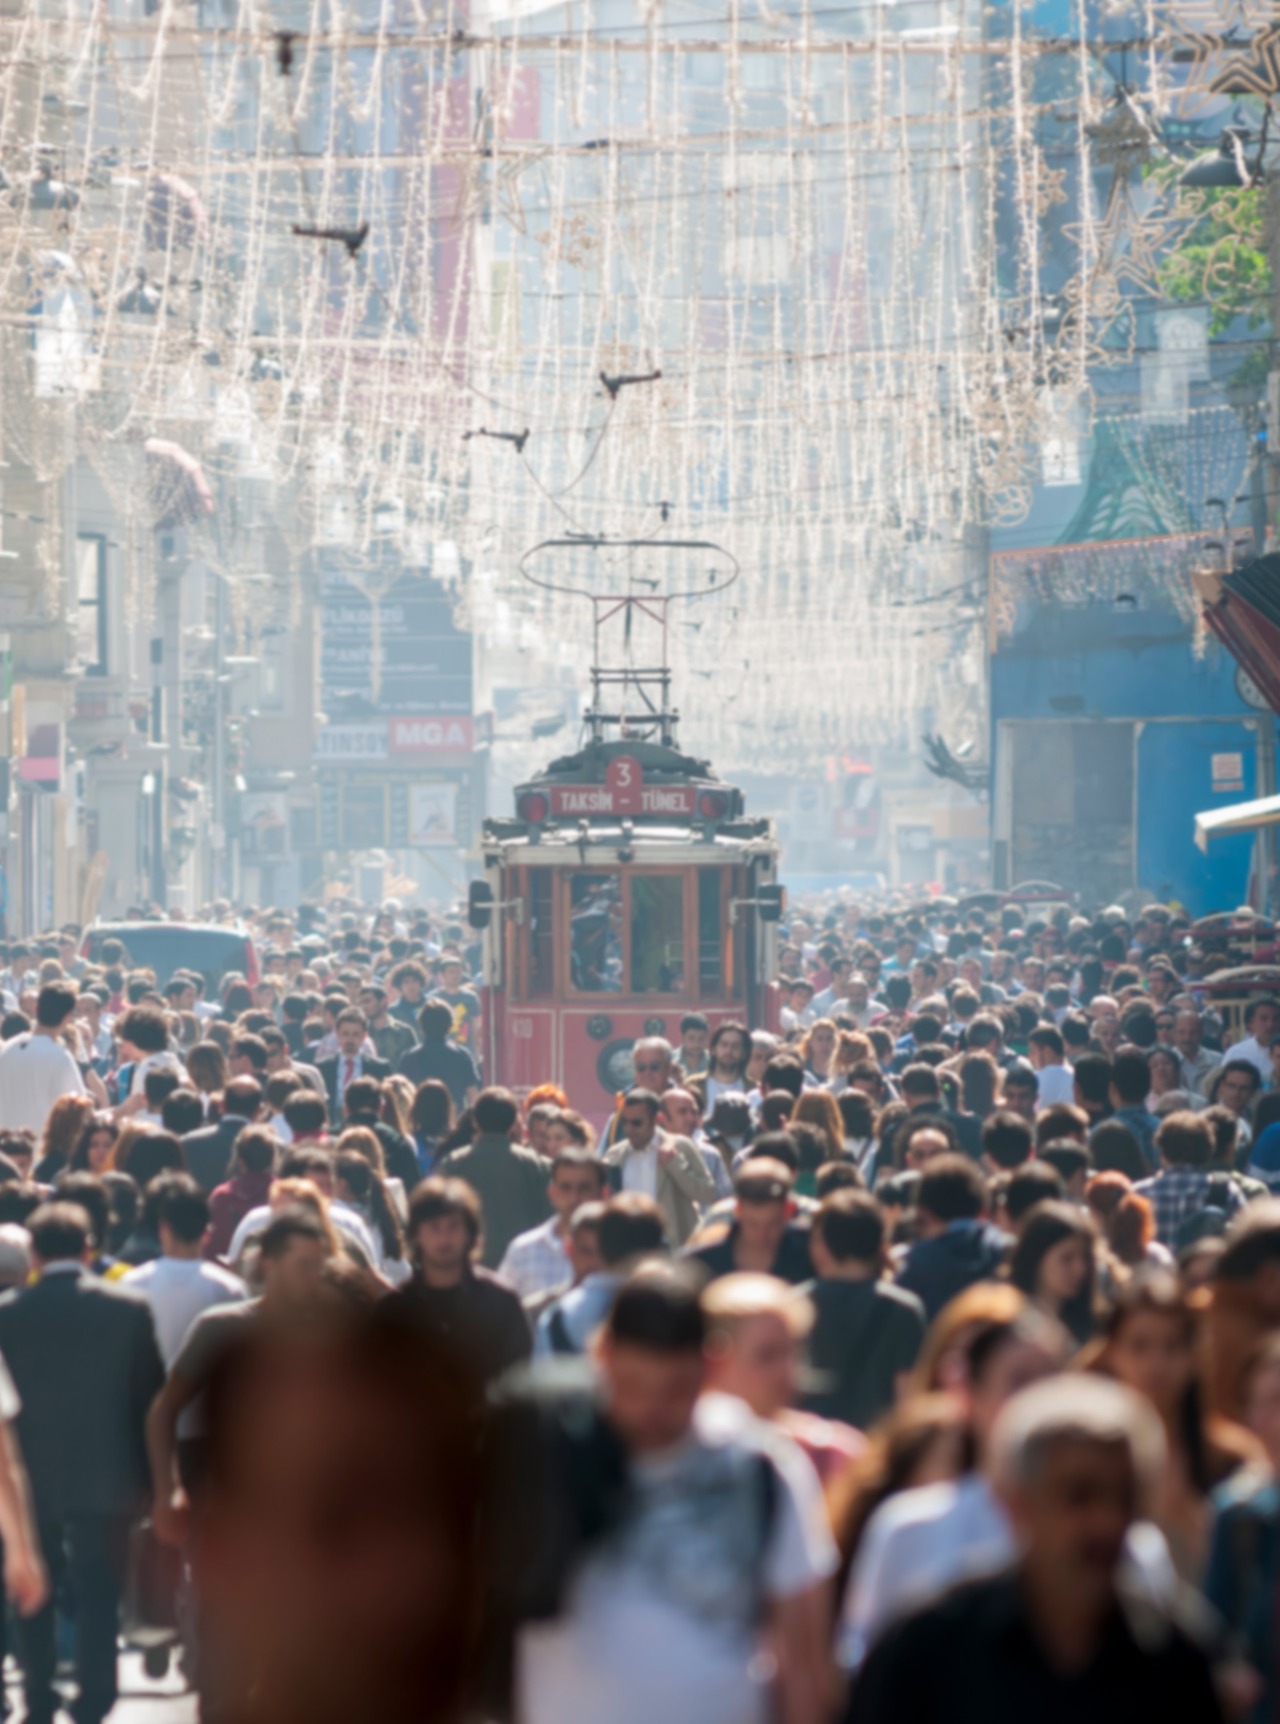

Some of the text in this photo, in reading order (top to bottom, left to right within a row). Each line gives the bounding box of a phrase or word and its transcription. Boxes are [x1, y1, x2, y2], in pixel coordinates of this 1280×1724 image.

[395, 722, 466, 746] MGA
[616, 763, 632, 787] 3
[560, 788, 613, 811] TAKSİM
[640, 788, 690, 812] TÜNEL
